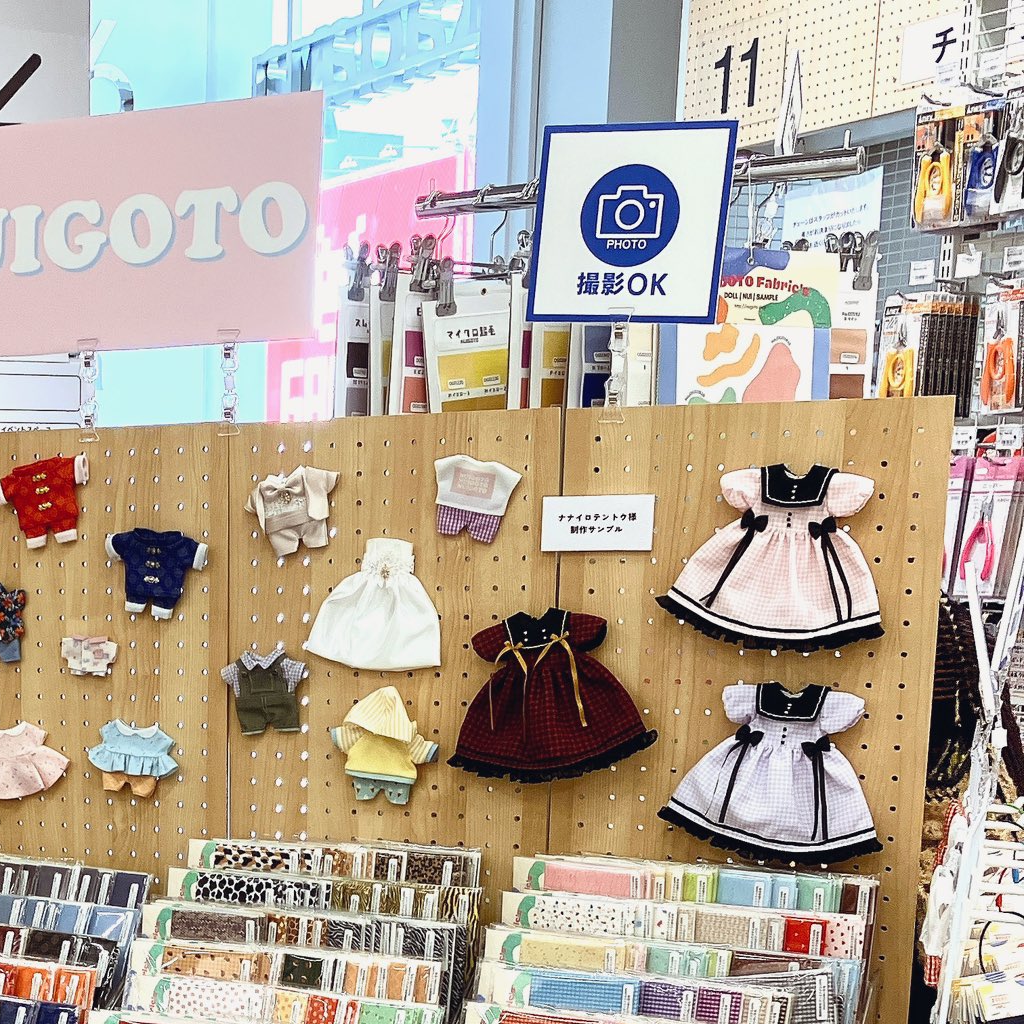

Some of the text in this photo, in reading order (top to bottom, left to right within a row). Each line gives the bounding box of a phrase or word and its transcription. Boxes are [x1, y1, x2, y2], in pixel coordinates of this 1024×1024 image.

[932, 27, 956, 63] チ
[714, 37, 762, 114] 11
[606, 238, 647, 251] PHOTO
[576, 272, 667, 298] 撮影OK
[724, 292, 738, 300] DOLL
[756, 294, 778, 302] SAMPLE
[446, 324, 496, 338] マイクロ起毛
[558, 512, 637, 522] ナナイロテントウ様
[570, 525, 623, 534] 制作サンプル
